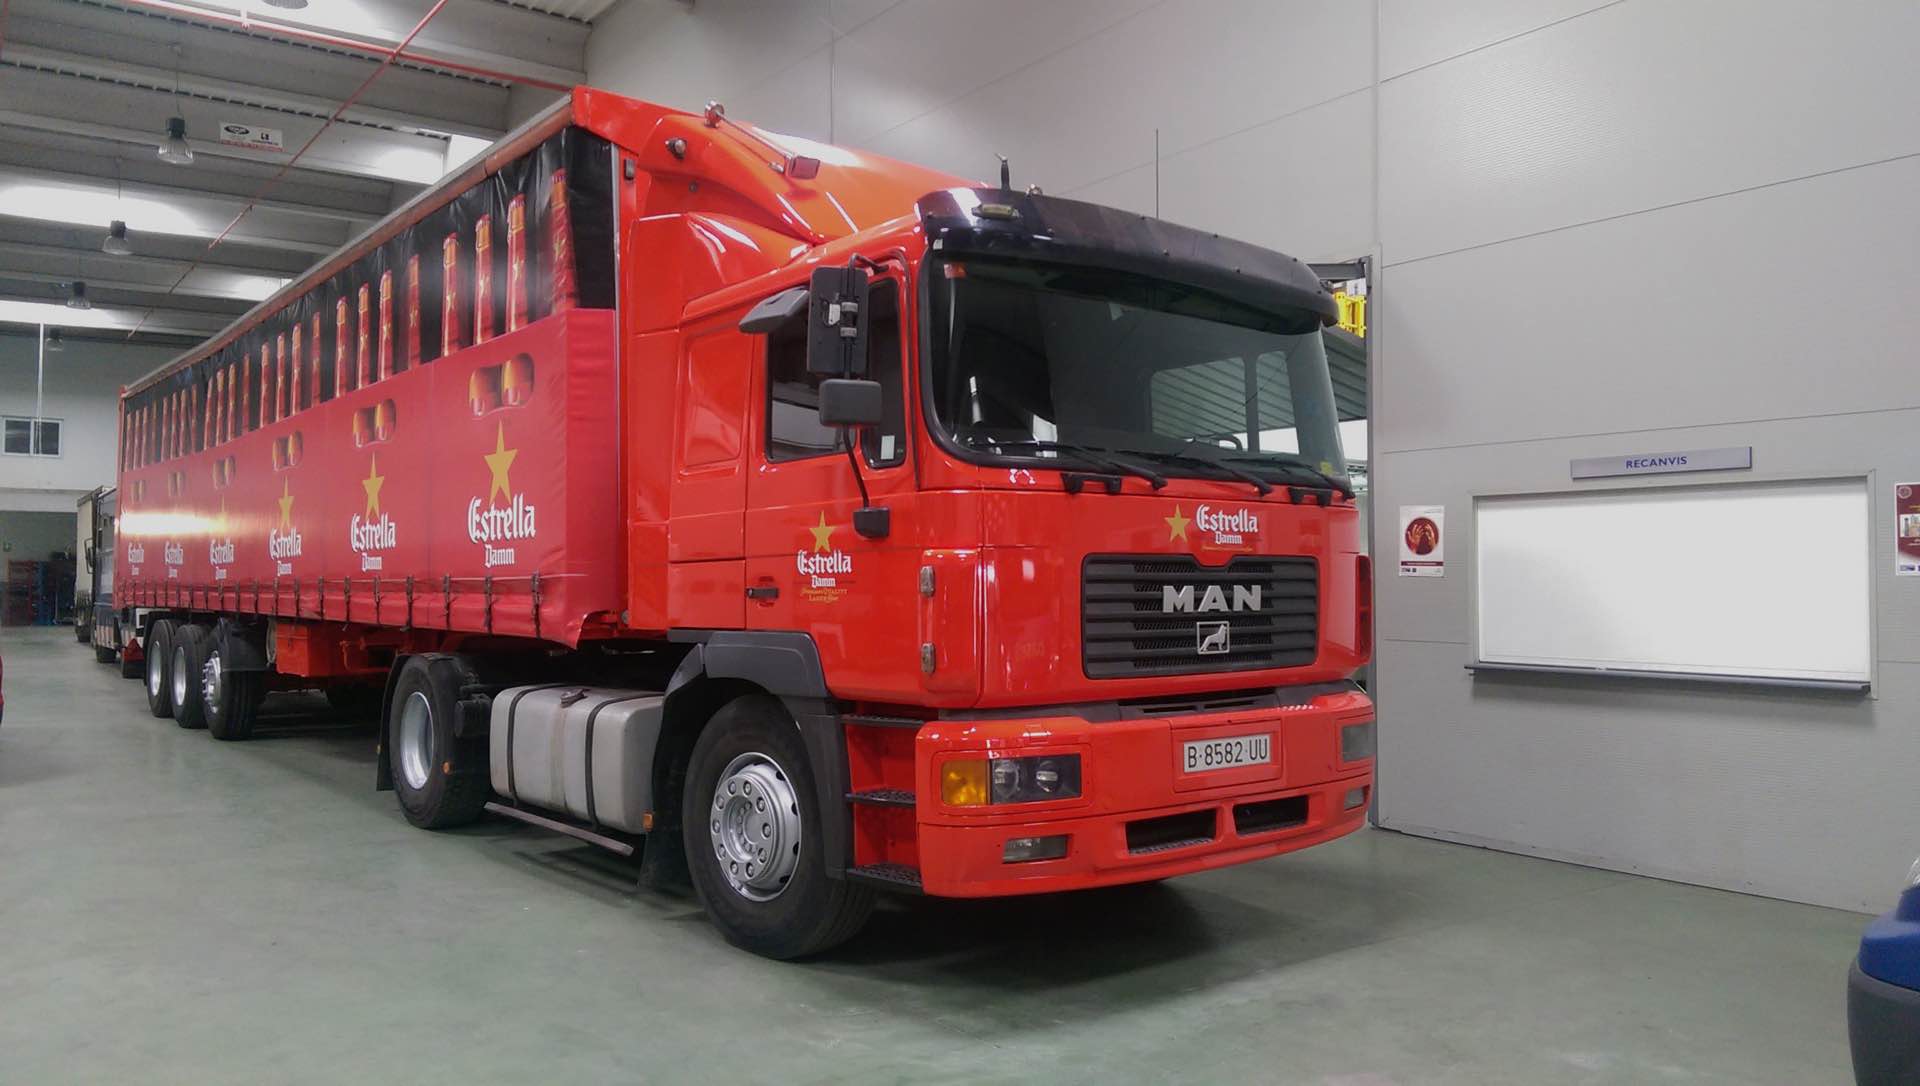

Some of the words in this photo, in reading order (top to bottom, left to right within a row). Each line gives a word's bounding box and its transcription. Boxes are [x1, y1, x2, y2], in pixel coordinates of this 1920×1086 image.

[1625, 456, 1688, 469] RECANVIS
[467, 493, 536, 543] Estrella
[1196, 504, 1258, 532] Estrella
[269, 528, 302, 560] Estrella
[350, 512, 396, 552] Estrella
[1215, 531, 1242, 544] Damm
[484, 544, 515, 568] Damm
[797, 549, 852, 575] Estrella
[811, 575, 836, 588] Damm
[1163, 585, 1262, 613] MAN
